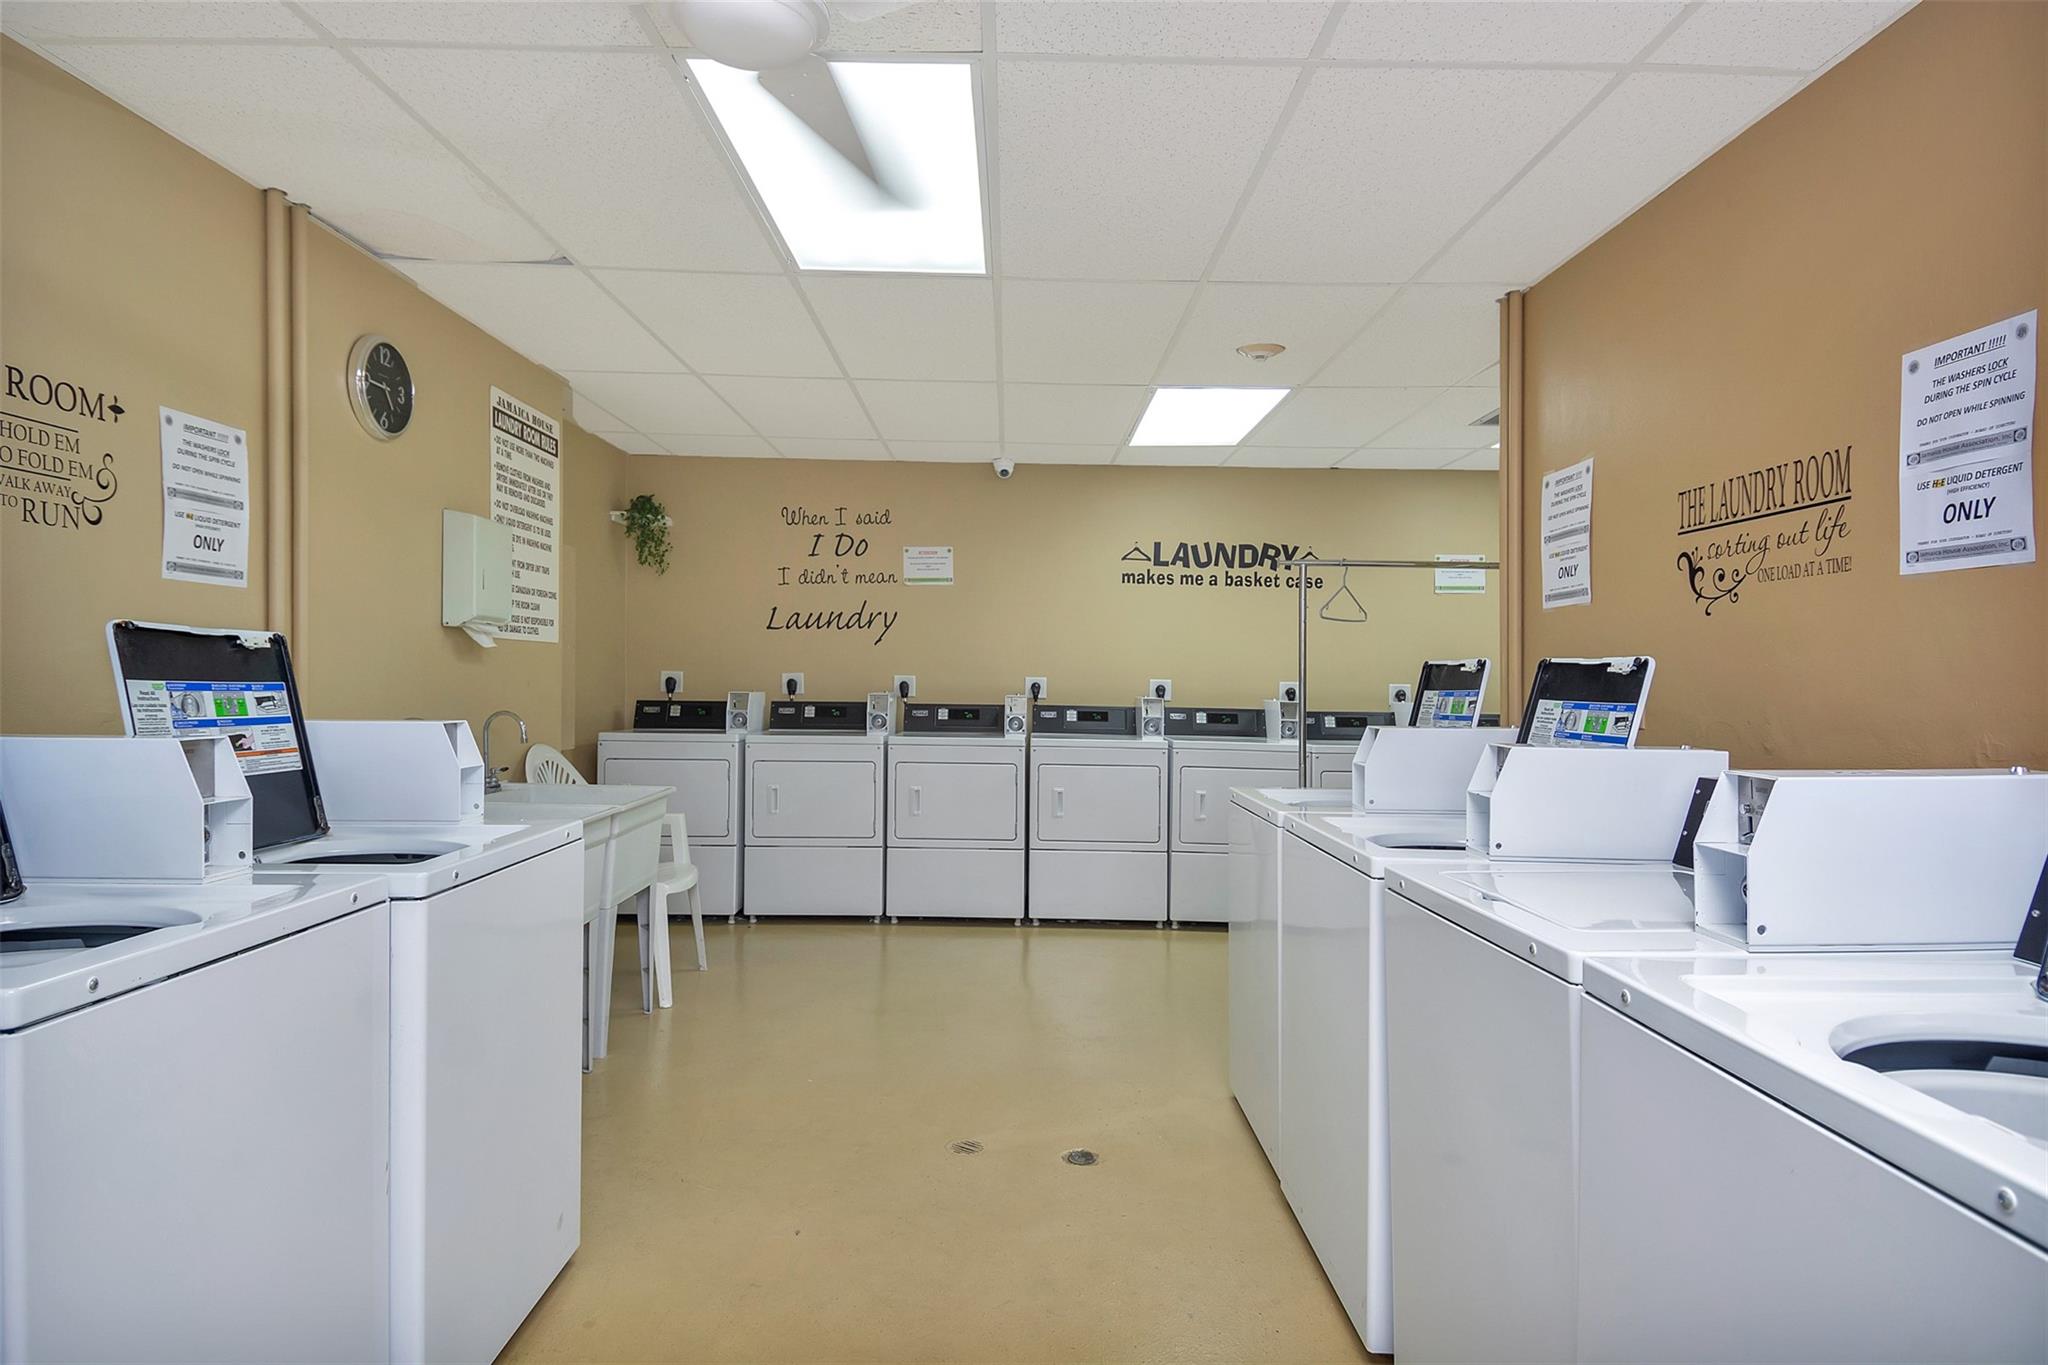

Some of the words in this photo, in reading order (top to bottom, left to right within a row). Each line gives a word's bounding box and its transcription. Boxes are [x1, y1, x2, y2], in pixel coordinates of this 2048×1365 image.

[380, 346, 394, 367] 12
[1934, 341, 1987, 367] IMPORTANT
[1988, 334, 2007, 349] !!!!!
[1924, 388, 1954, 404] DURING
[1955, 383, 1971, 395] THE
[1972, 377, 1992, 390] SPIN
[1993, 369, 2017, 384] CYCLE
[1932, 377, 1946, 388] THE
[1948, 366, 1987, 384] WASHERS
[1988, 357, 2010, 372] LOCK
[5, 364, 106, 422] ROOM
[397, 386, 405, 404] 3
[380, 412, 389, 429] 6
[496, 396, 530, 422] JAMAICA
[532, 414, 554, 435] HOUSE
[1916, 417, 1928, 427] DO
[1929, 413, 1943, 424] NOT
[1943, 408, 1962, 421] OPEN
[1963, 400, 1988, 415] WHILE
[1989, 391, 2027, 409] SPINNING
[0, 420, 50, 447] HOLD
[54, 433, 81, 454] EM
[523, 424, 541, 449] ROOM
[17, 449, 64, 474] FOLD
[68, 460, 95, 480] EM
[1916, 480, 1931, 491] USE
[1947, 471, 1973, 485] LIQUID
[1975, 462, 2024, 480] DETERGENT
[33, 480, 72, 499] AWAY
[1677, 486, 1706, 530] THE
[1709, 463, 1789, 523] LAUNDRY
[1793, 446, 1852, 505] ROOM
[21, 497, 81, 530] RUN
[781, 506, 829, 526] When
[835, 507, 847, 526] I
[855, 509, 892, 526] said
[1943, 496, 1997, 524] ONLY
[193, 534, 225, 552] ONLY
[808, 533, 824, 557] I
[835, 532, 869, 558] Do
[1706, 533, 1771, 575] sorting
[1777, 520, 1810, 549] out
[1814, 504, 1852, 557] life
[1153, 541, 1300, 572] LAUNDRY
[1757, 566, 1776, 583] ONE
[1776, 563, 1801, 581] LOAD
[1802, 561, 1816, 577] AT
[1817, 562, 1825, 577] A
[1826, 556, 1852, 576] TIME!
[777, 566, 791, 586] I
[798, 564, 850, 586] didn't
[855, 571, 898, 585] mean
[1121, 569, 1175, 586] makes
[1179, 573, 1204, 586] me
[1209, 574, 1218, 586] a
[1225, 571, 1280, 588] basket
[1558, 563, 1579, 580] ONLY
[766, 599, 898, 646] Laundry
